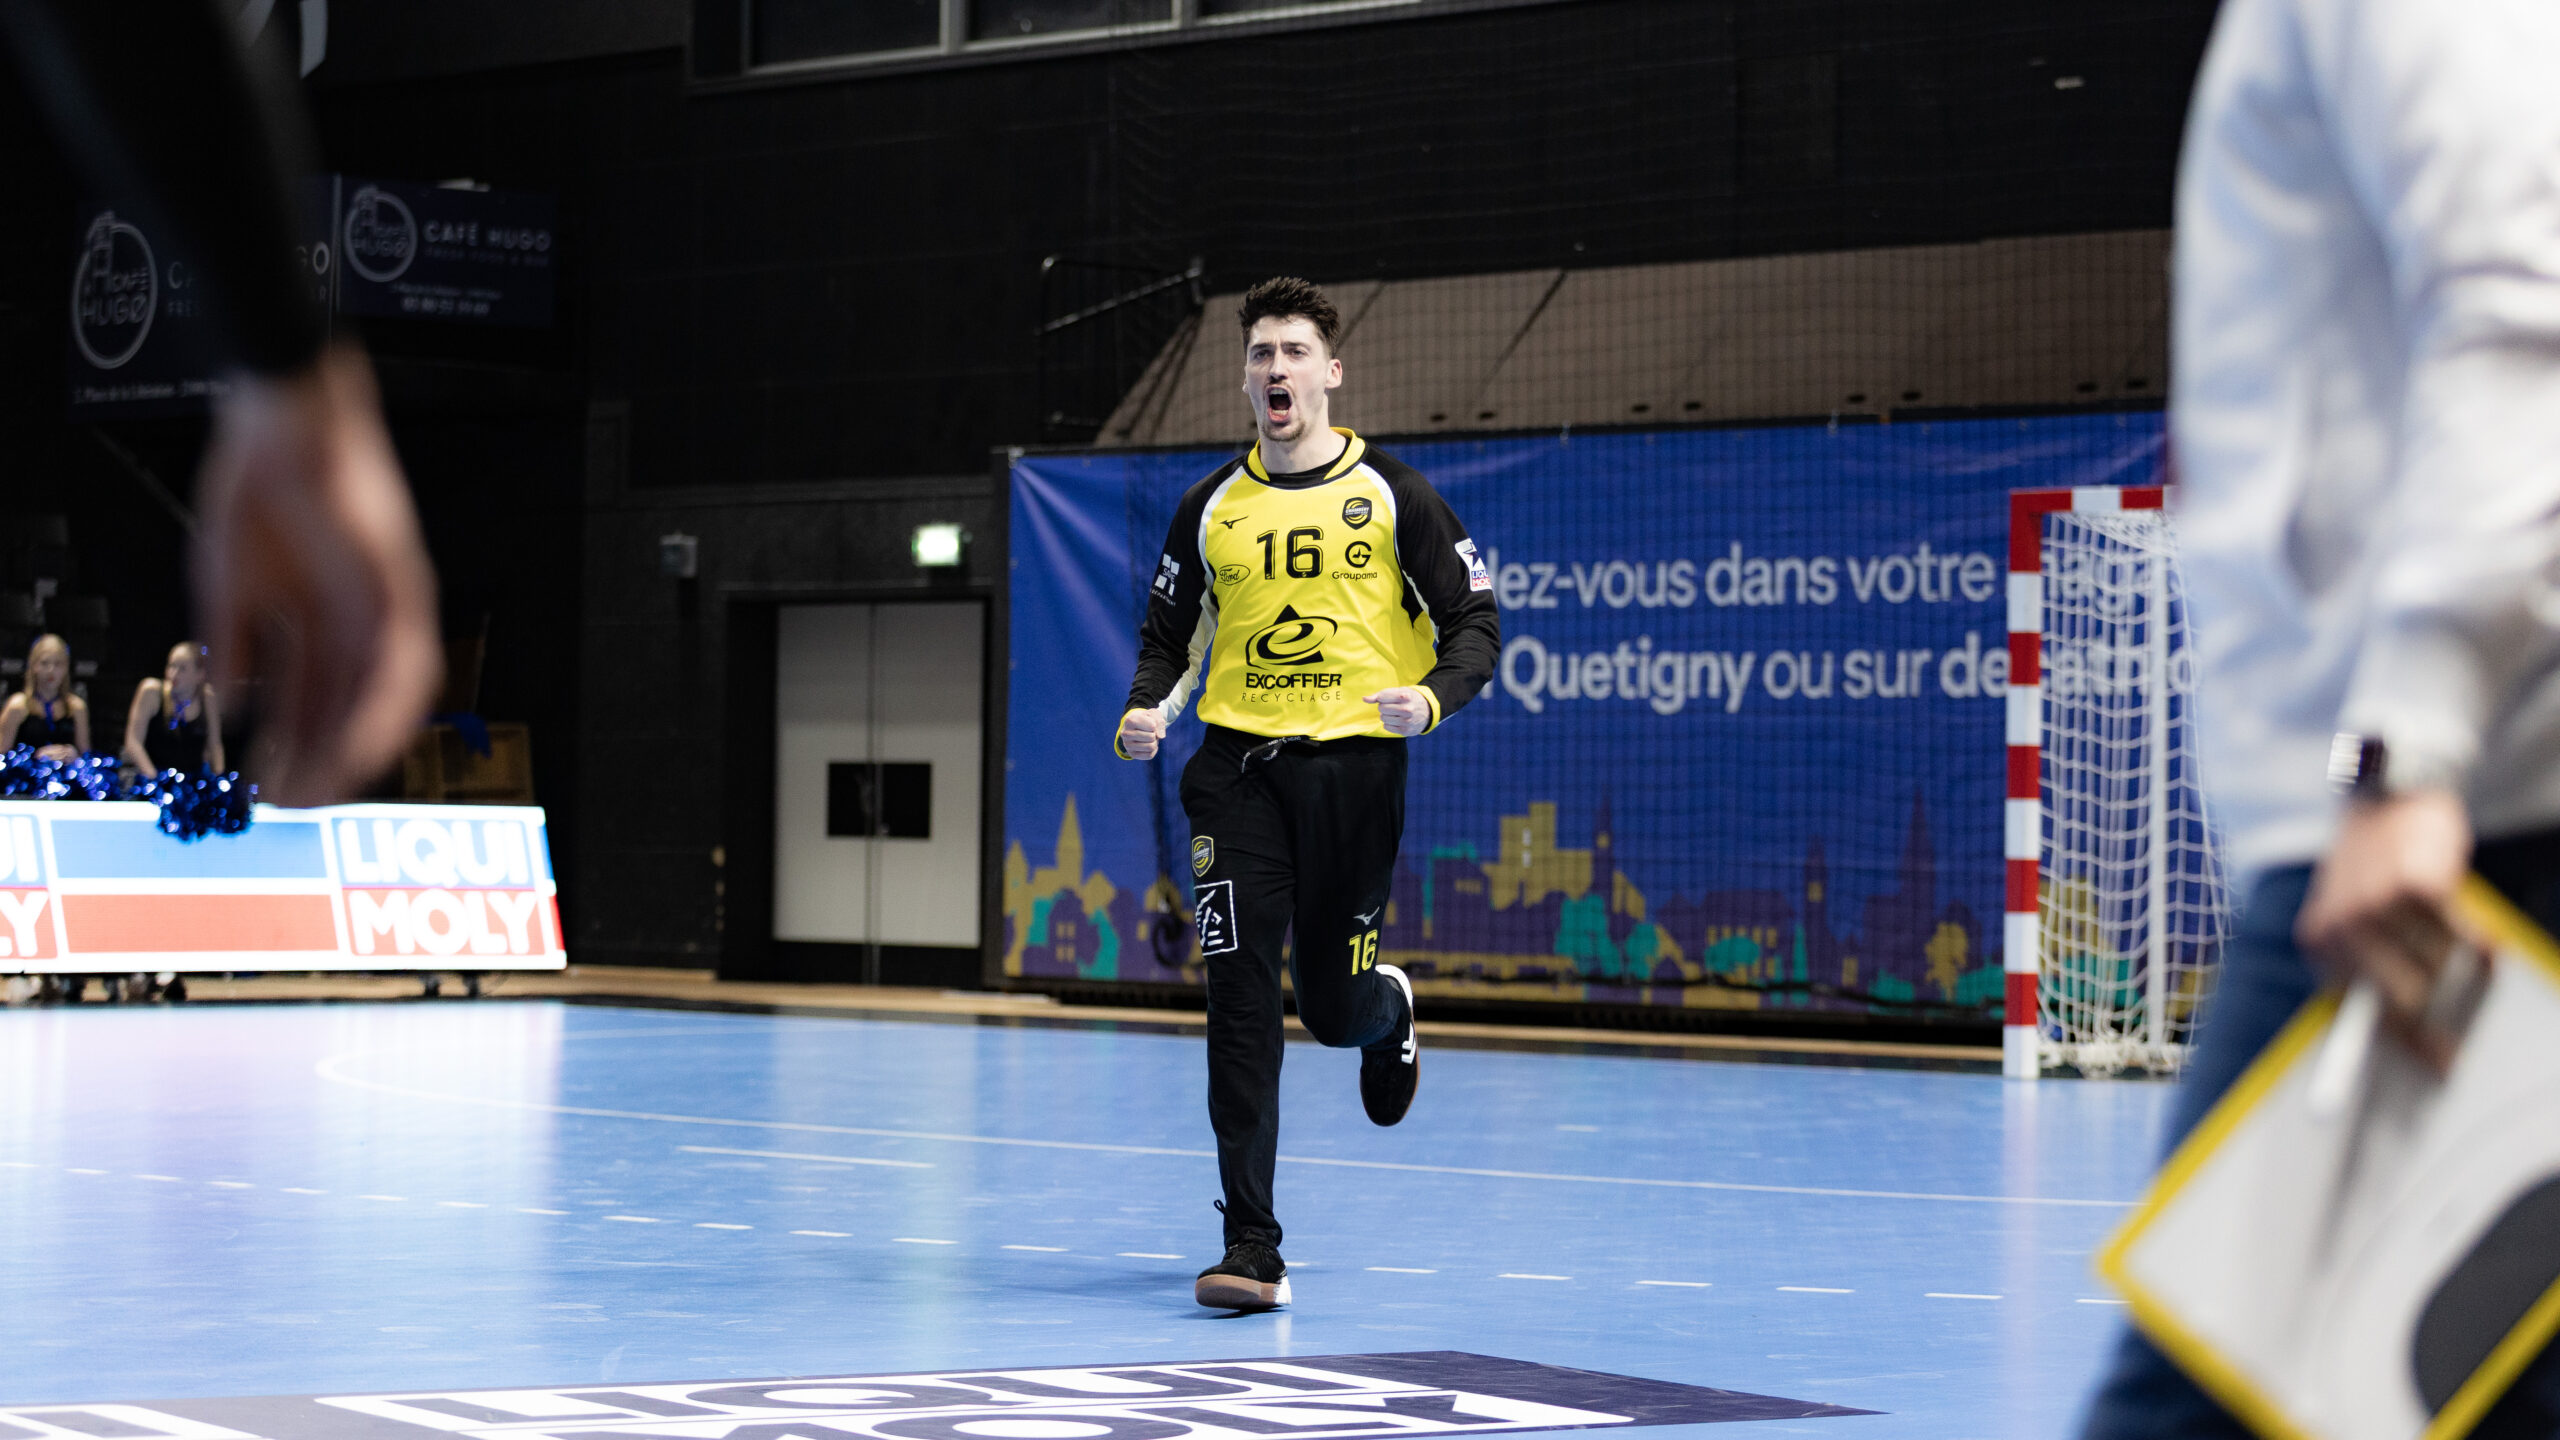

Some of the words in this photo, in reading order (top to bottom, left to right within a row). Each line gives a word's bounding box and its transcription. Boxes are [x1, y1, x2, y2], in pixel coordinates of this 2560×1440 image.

[1257, 525, 1324, 580] 16
[1331, 571, 1378, 581] Groupama
[1705, 541, 1837, 607] dans
[1845, 541, 1994, 604] votre
[1241, 691, 1342, 703] RECYCLAGE
[1246, 672, 1343, 690] EXCOFFIER
[1501, 635, 1754, 714] Quetigny
[1762, 650, 1834, 698] ou
[1842, 646, 1931, 698] sur
[338, 818, 529, 888] LIQUI
[348, 889, 540, 956] MOLY
[1348, 928, 1378, 976] 16
[380, 1365, 1368, 1423] LIQUI
